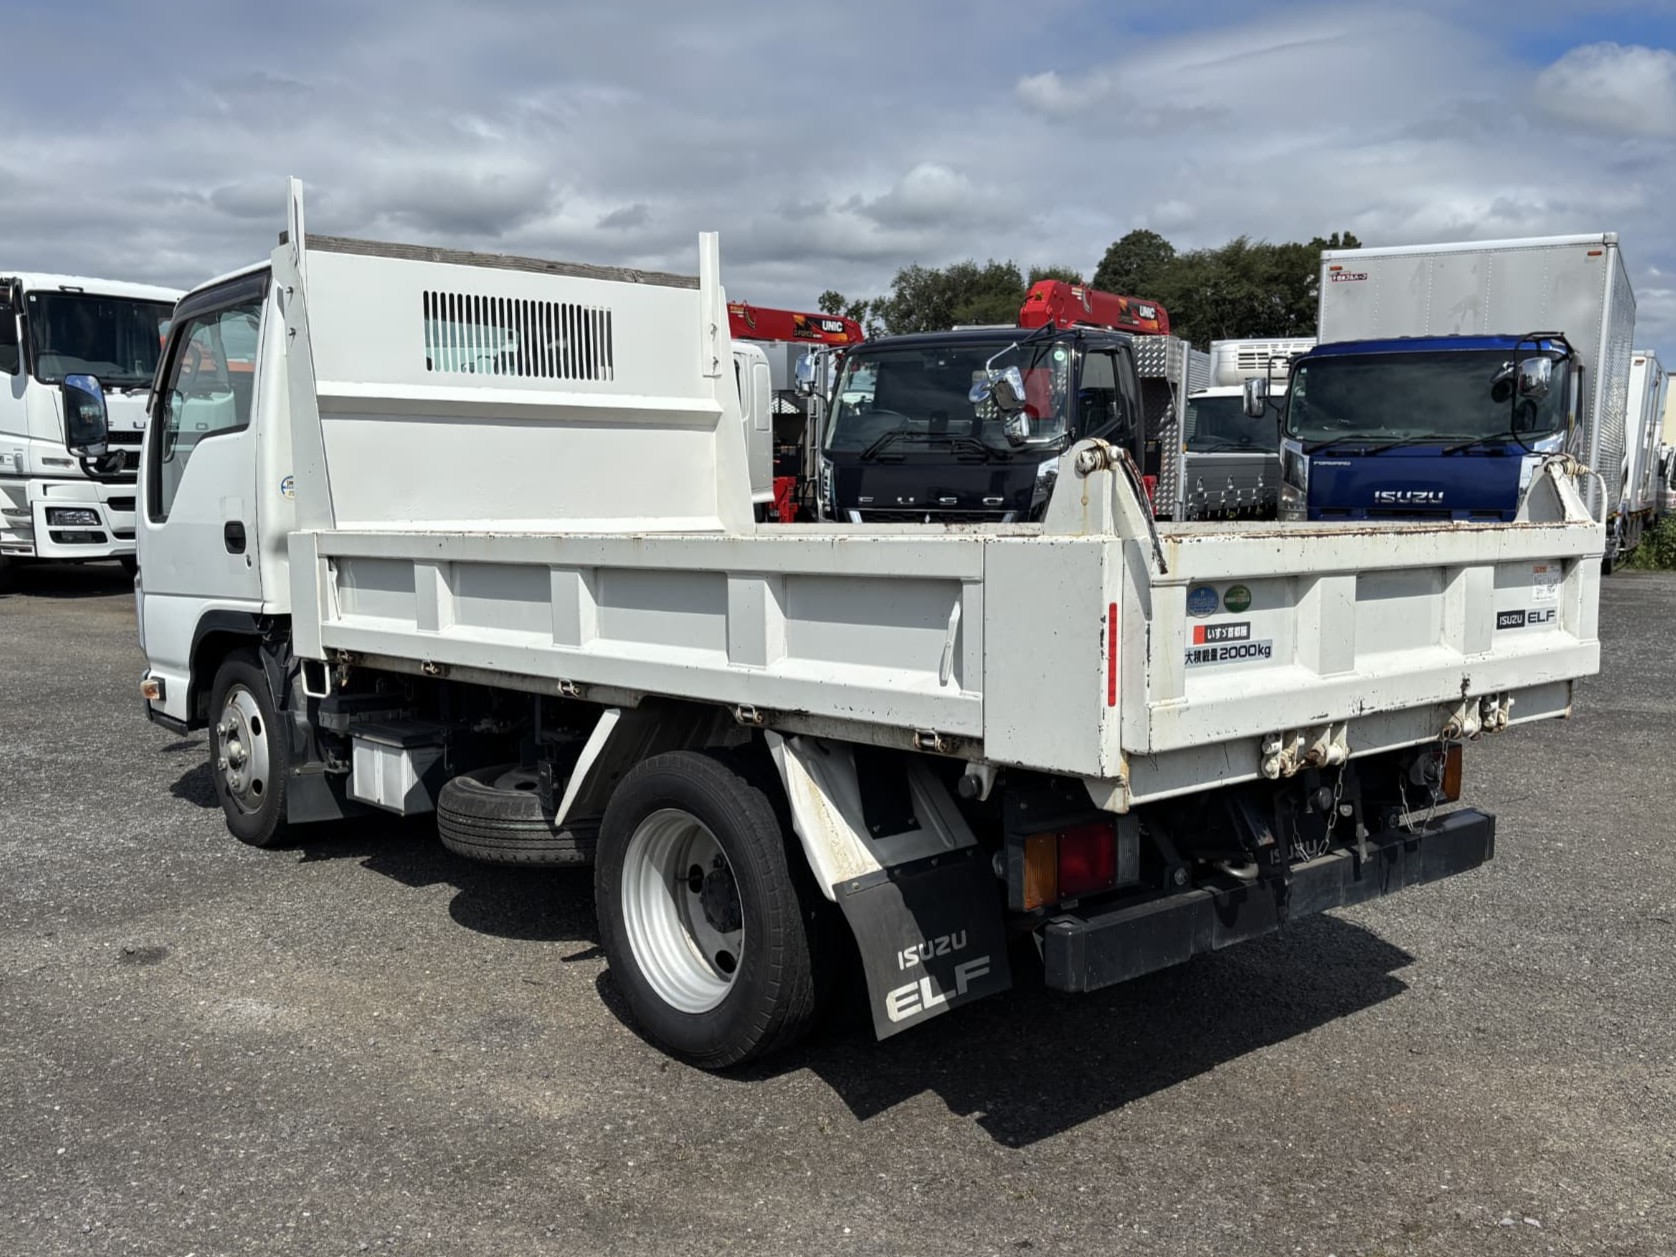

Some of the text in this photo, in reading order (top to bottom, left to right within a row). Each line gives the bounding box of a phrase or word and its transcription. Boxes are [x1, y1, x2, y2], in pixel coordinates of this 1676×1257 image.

[821, 320, 843, 332] UNIC
[1374, 491, 1444, 503] ISUZU
[1499, 610, 1555, 626] ISUZU ELF
[898, 930, 967, 970] ISUZU
[886, 955, 990, 1022] ELF
